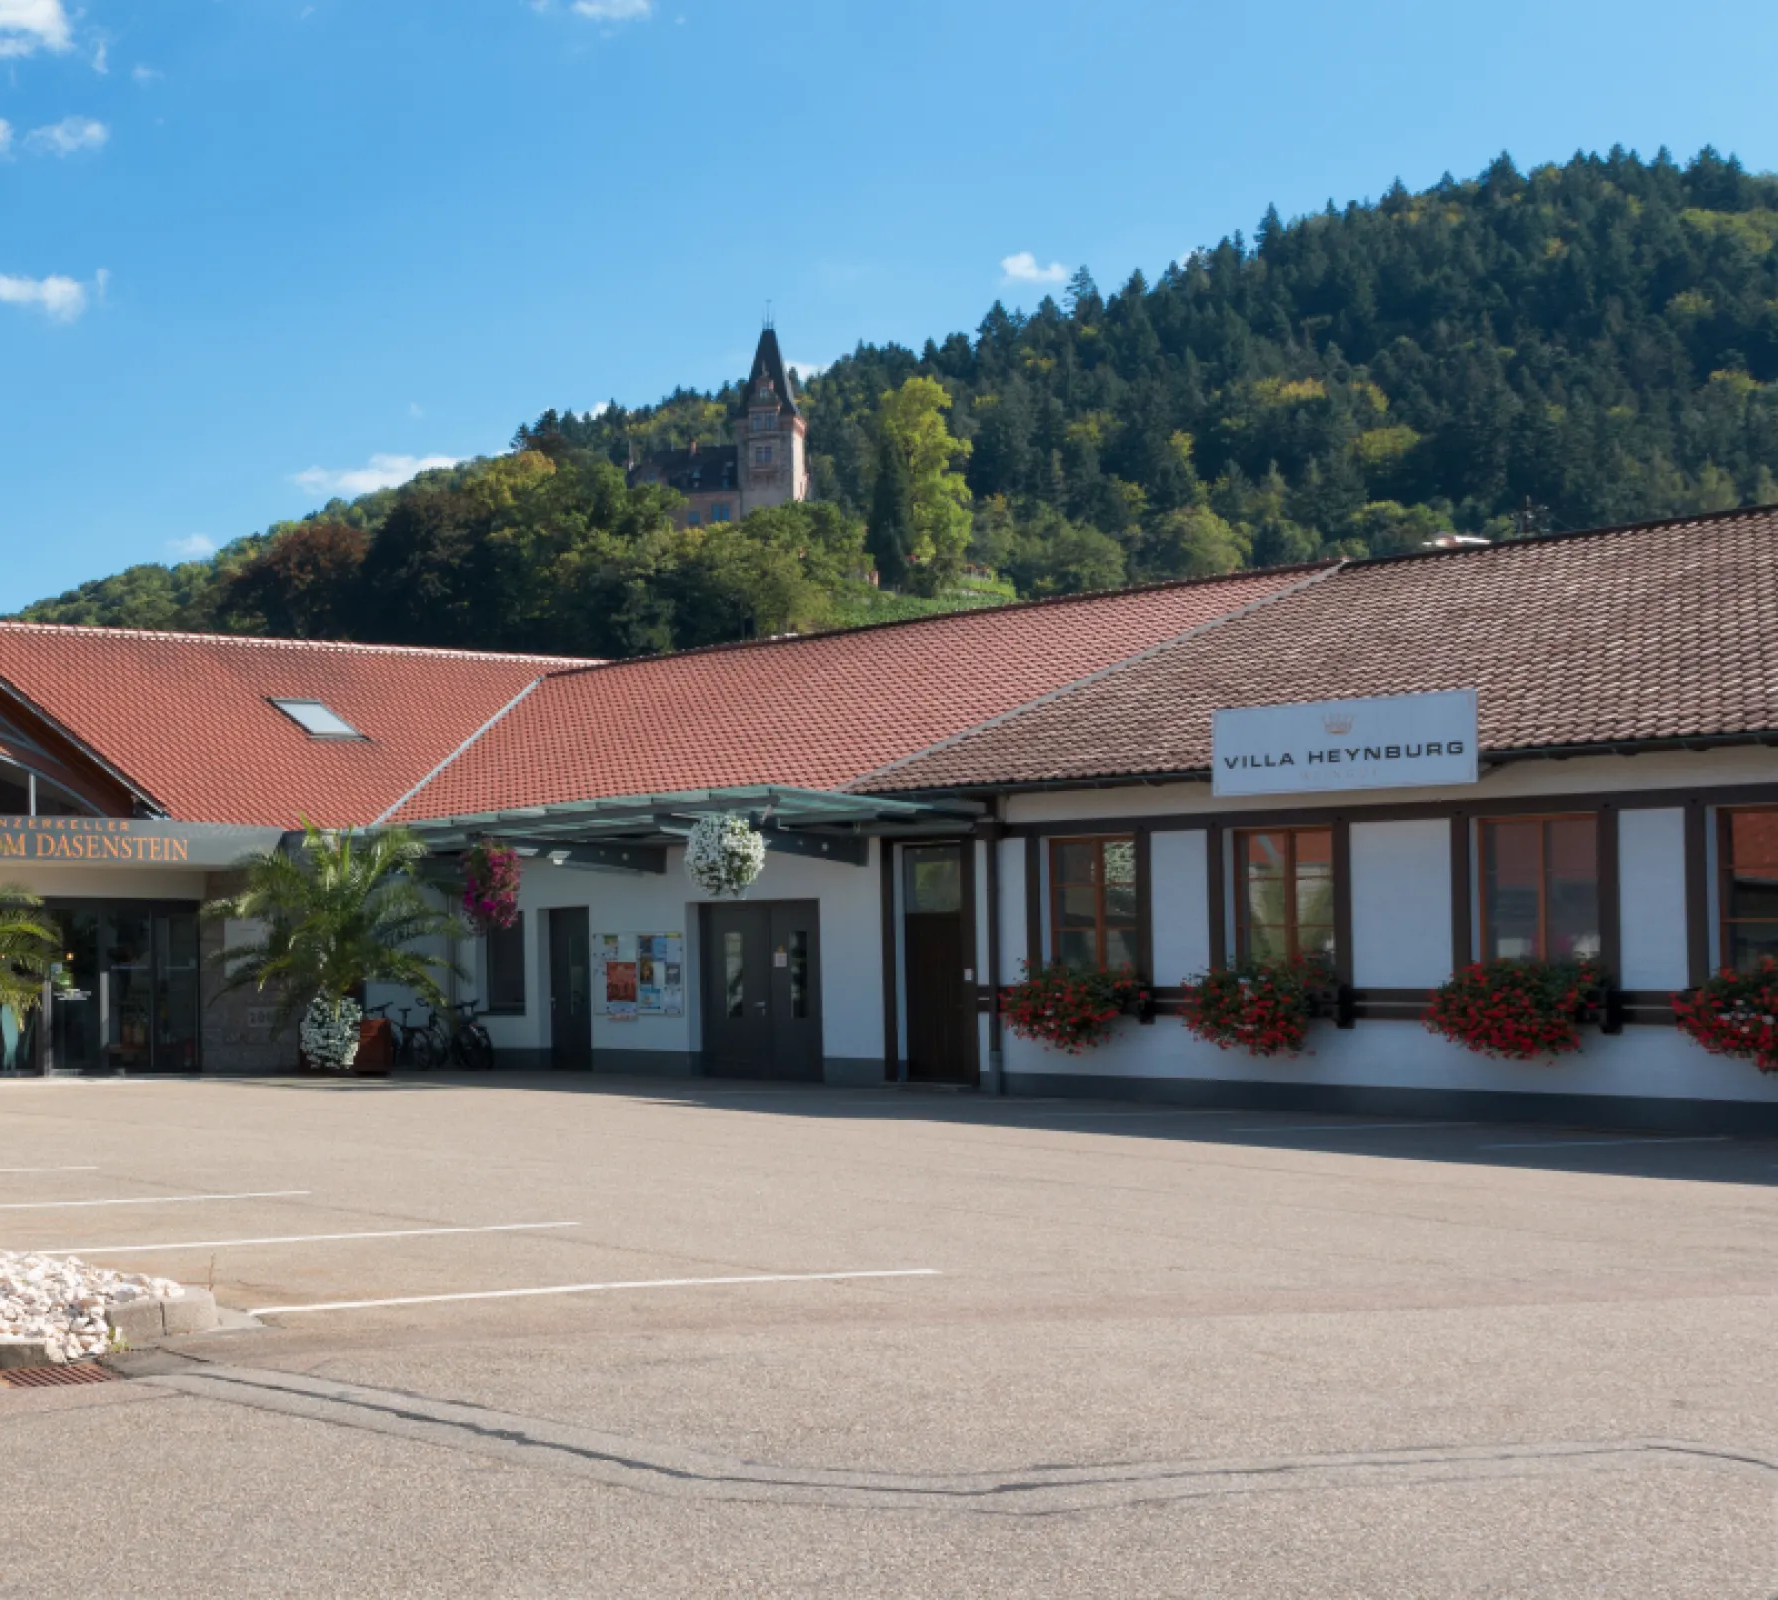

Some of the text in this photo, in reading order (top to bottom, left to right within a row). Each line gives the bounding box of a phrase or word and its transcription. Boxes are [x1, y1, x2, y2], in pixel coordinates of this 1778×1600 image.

[1224, 741, 1464, 770] VILLA HEYNBURG
[36, 834, 189, 861] DASENSTEIN
